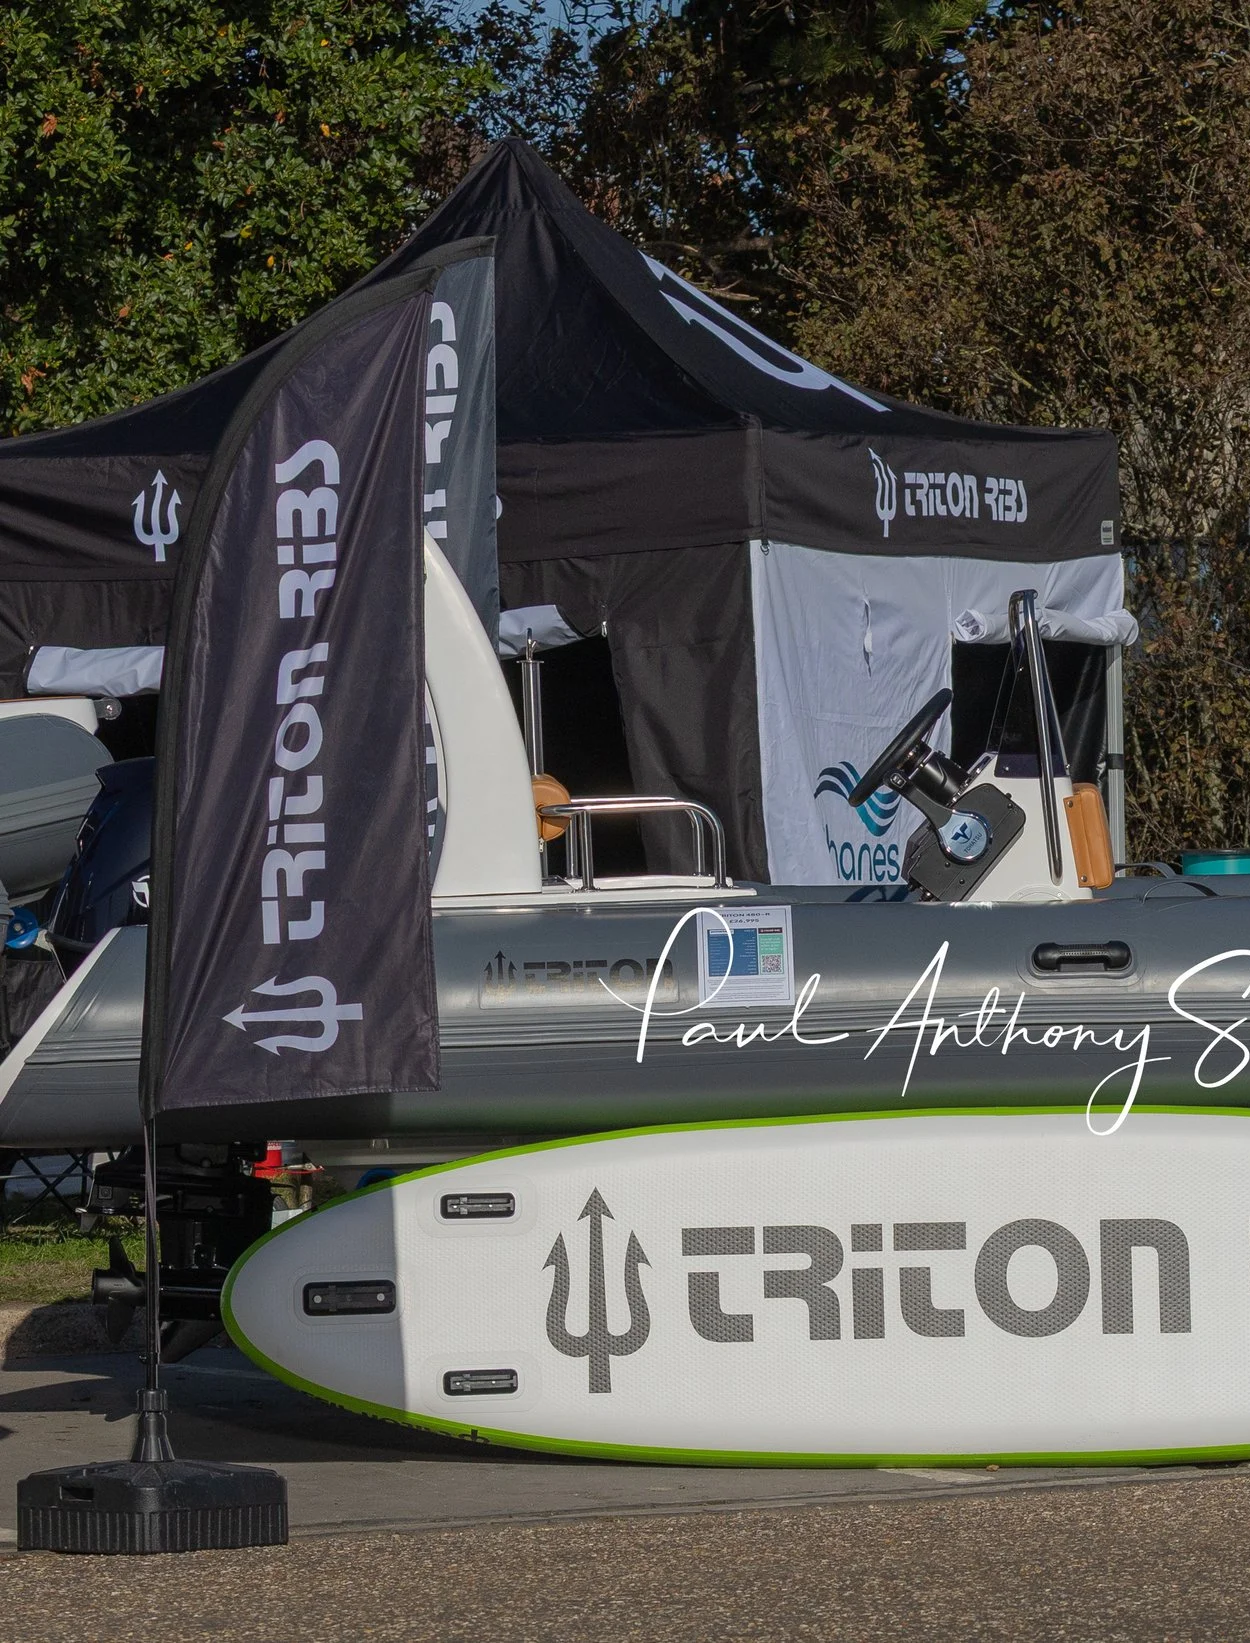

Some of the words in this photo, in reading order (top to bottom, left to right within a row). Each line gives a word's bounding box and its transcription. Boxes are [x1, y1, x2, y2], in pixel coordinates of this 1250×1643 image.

[275, 439, 340, 619] RIBS
[904, 471, 979, 519] TRITON
[984, 476, 1028, 523] RIBS
[261, 642, 329, 945] TRITON
[825, 823, 901, 882] hanes
[523, 957, 675, 994] TRITON
[682, 1217, 1191, 1343] TRITON
